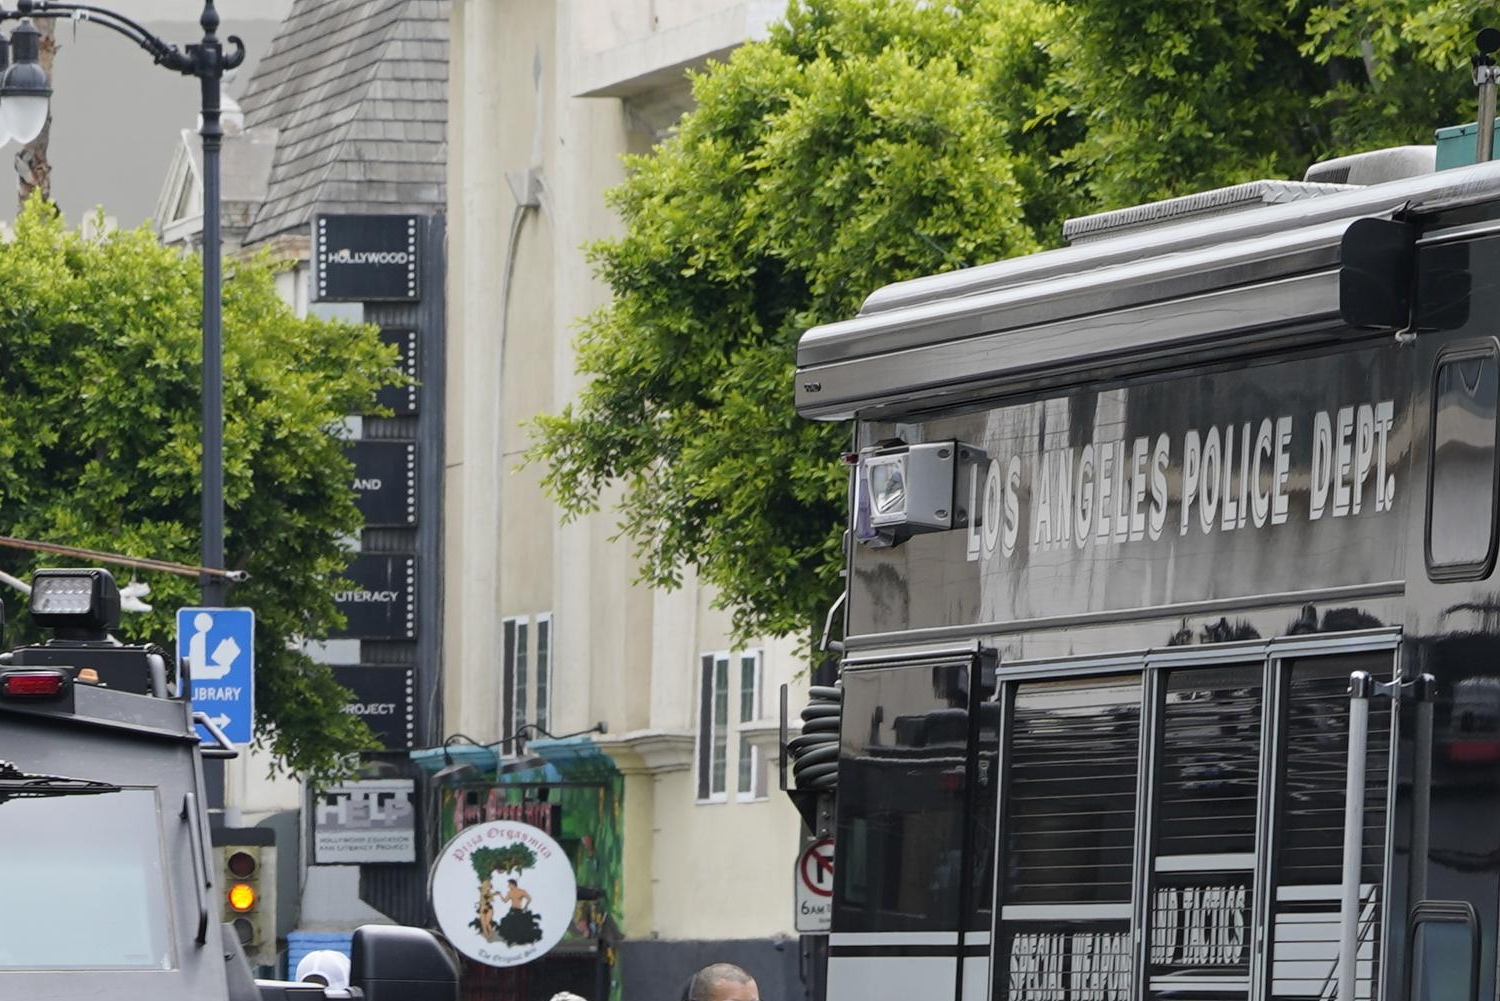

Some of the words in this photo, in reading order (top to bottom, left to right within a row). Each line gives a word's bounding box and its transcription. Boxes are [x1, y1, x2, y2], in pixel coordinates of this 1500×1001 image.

[327, 251, 408, 265] HOLLYWOOD
[352, 478, 382, 491] AND
[966, 454, 1022, 563] LOS
[1032, 431, 1171, 554] ANGELES
[1179, 414, 1294, 537] POLICE
[1308, 399, 1397, 522] DEPT.
[334, 590, 399, 603] LITERACY
[1181, 883, 1247, 966] TACTICS
